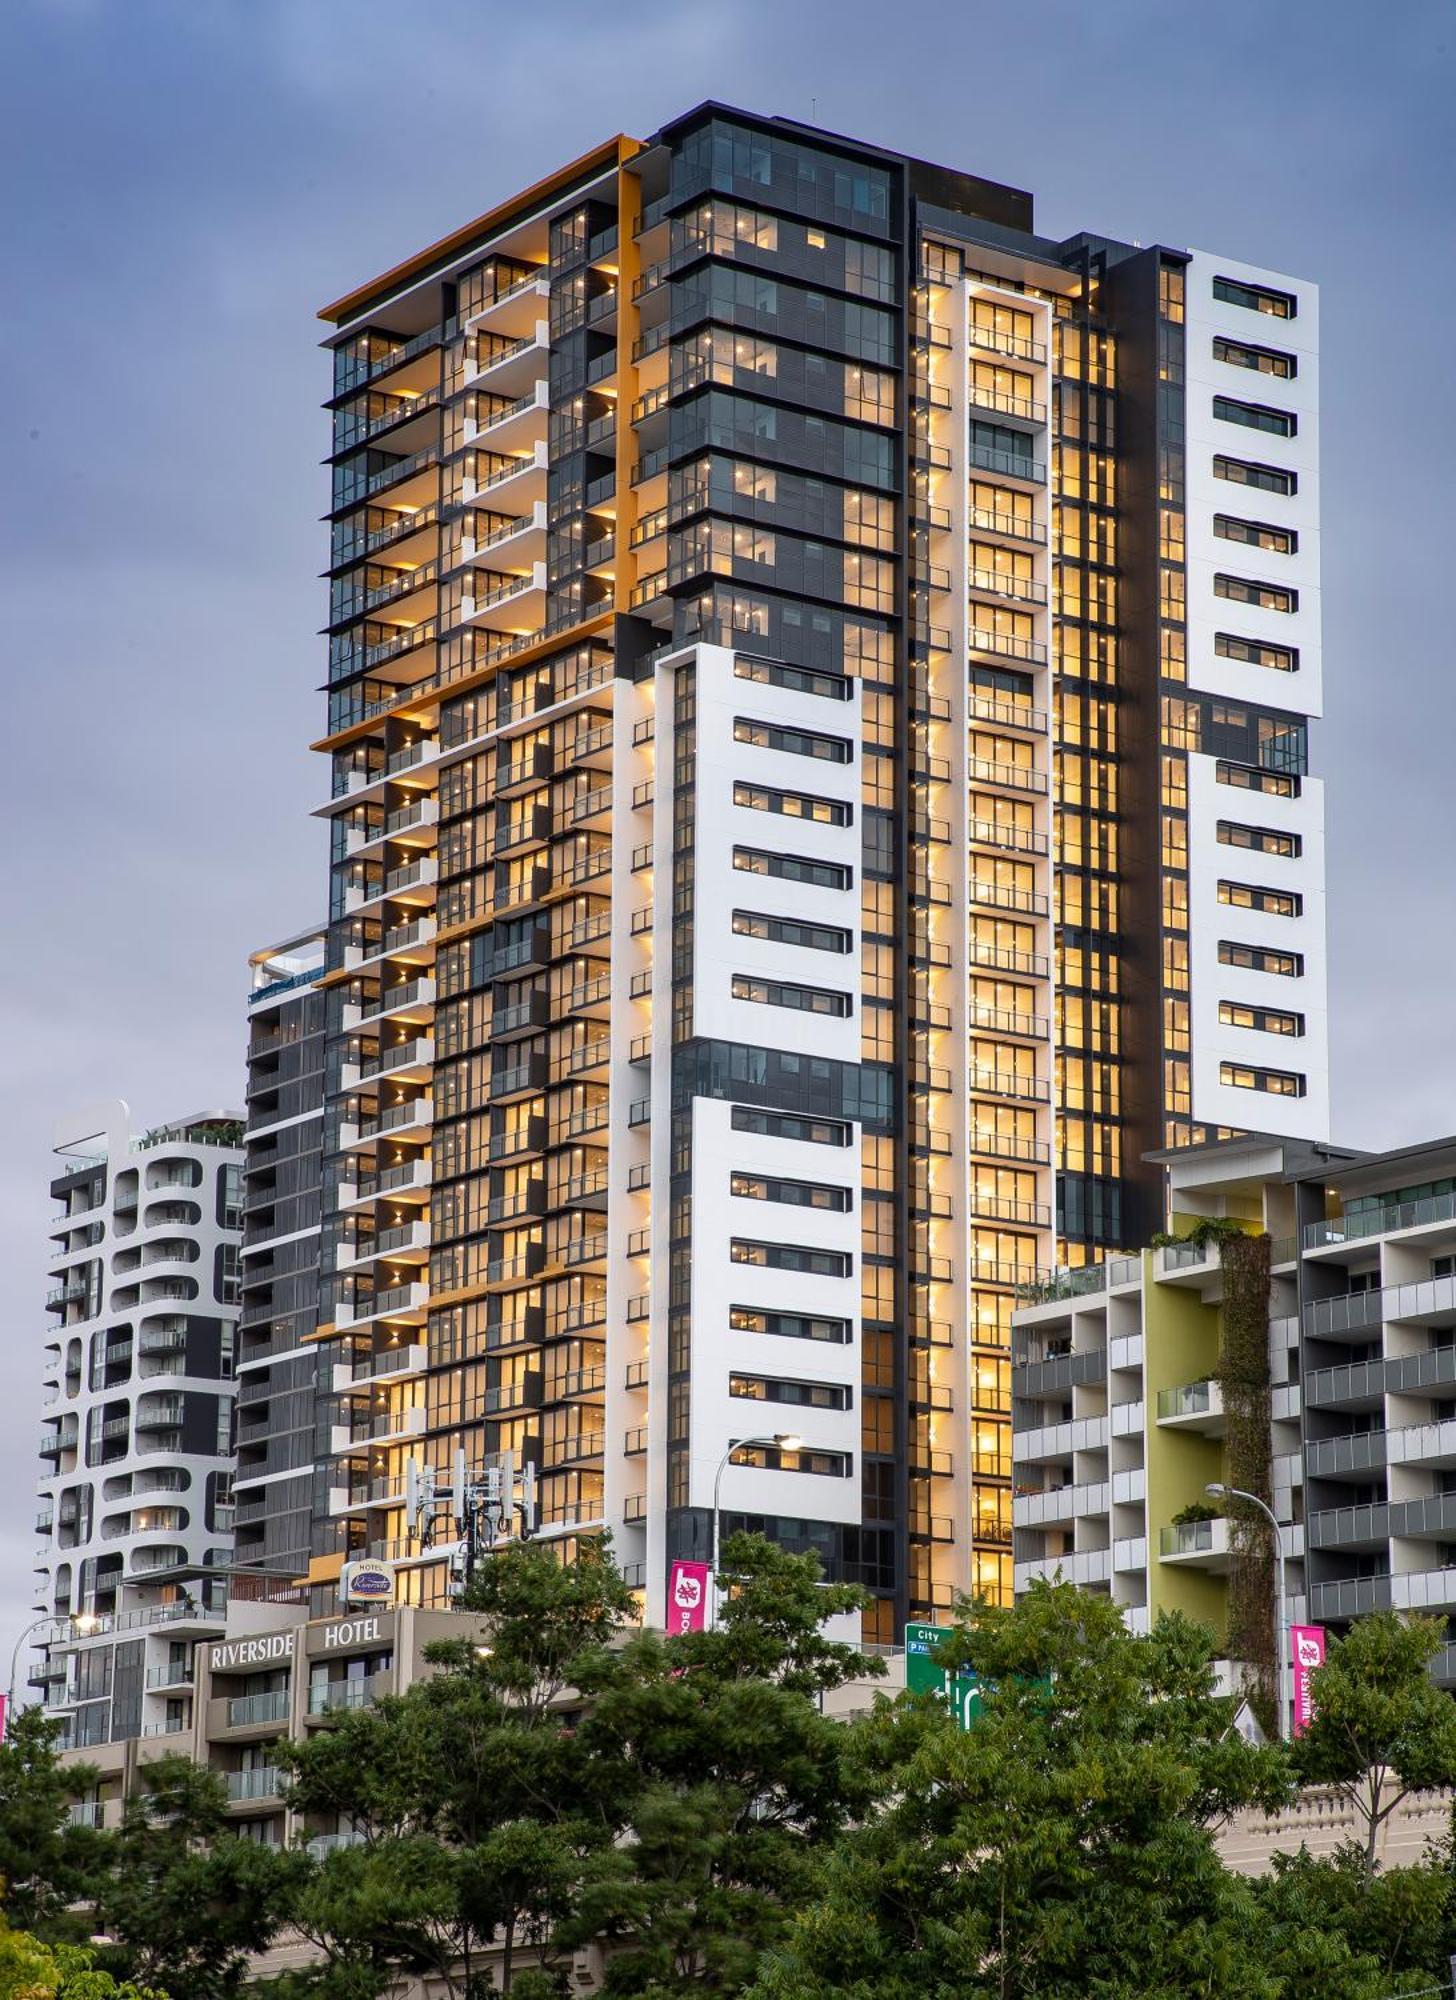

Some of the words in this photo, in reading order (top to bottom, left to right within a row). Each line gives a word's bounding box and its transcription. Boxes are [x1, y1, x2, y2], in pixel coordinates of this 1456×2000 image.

[211, 1634, 293, 1669] RIVERSIDE
[325, 1617, 382, 1648] HOTEL
[918, 1630, 940, 1643] City
